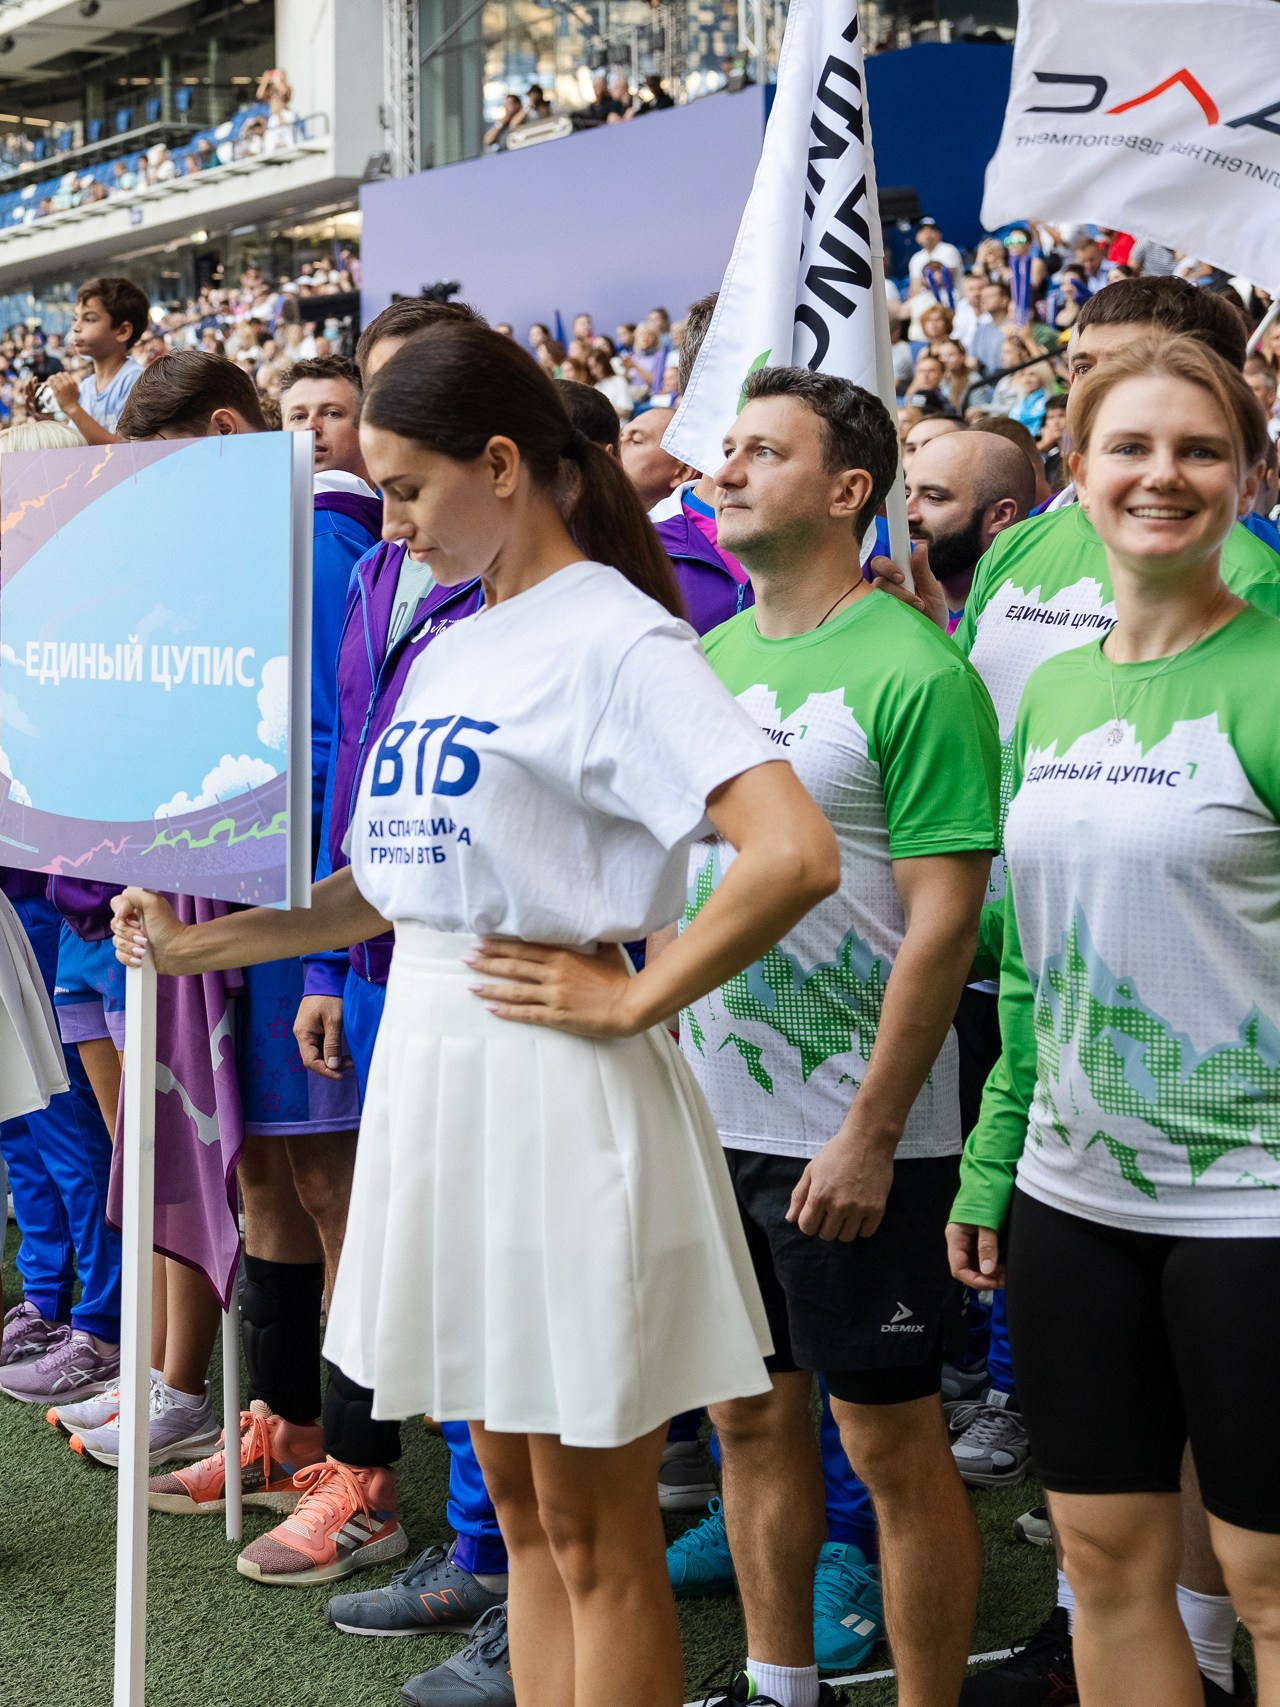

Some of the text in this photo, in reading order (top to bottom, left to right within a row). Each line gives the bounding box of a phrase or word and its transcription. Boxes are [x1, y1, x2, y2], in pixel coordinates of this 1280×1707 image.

[1005, 605, 1070, 627] ЕДИНЫЙ
[25, 634, 256, 692] ЕДИНЫЙ ЦУПИС
[370, 715, 499, 797] ВТБ
[1027, 761, 1181, 787] ЕДИНЫЙ ЦУПИС
[417, 845, 447, 864] ВТБ
[880, 1324, 926, 1333] DEMIX
